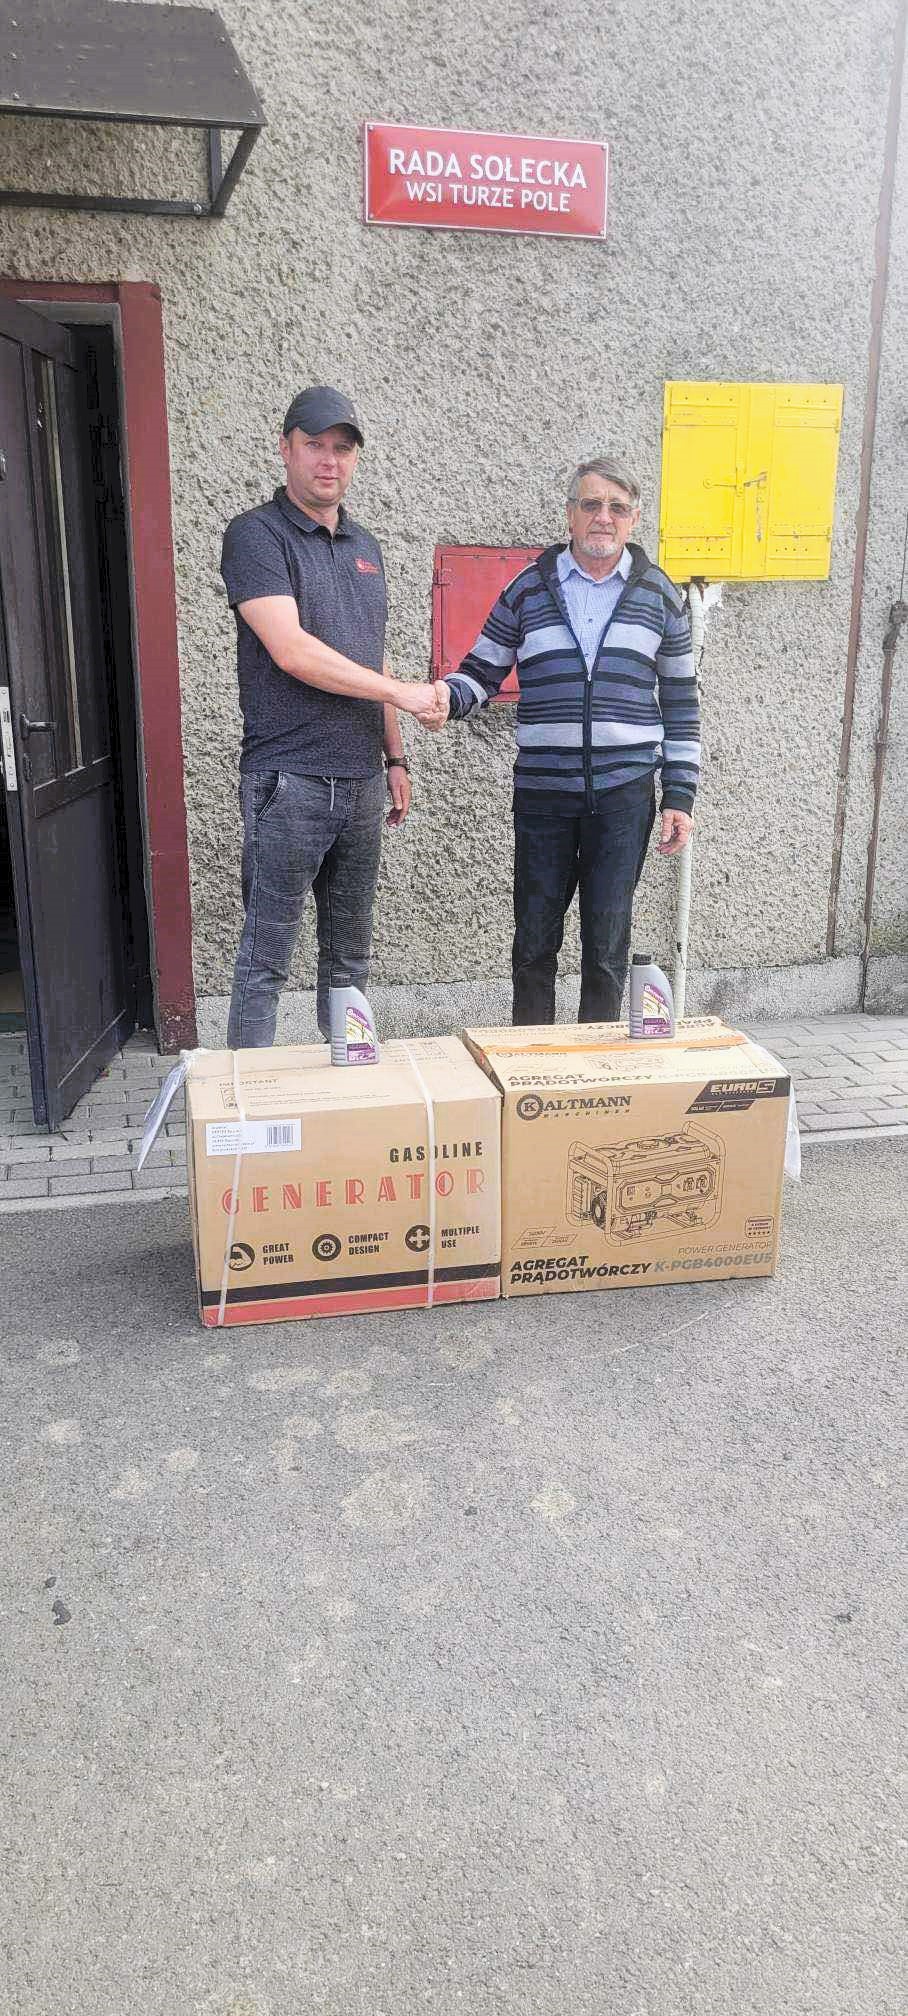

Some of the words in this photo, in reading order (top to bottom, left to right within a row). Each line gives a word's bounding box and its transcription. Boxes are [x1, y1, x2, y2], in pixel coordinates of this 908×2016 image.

[389, 149, 463, 178] RADA
[470, 154, 587, 189] SOŁECKA
[406, 181, 443, 203] WSI
[449, 184, 514, 208] TURZE
[521, 189, 571, 212] POLE
[710, 1082, 757, 1093] EURO
[222, 1168, 485, 1216] GENERATOR
[441, 1225, 480, 1237] MULTIPLE
[348, 1232, 389, 1244] COMPACT
[441, 1239, 457, 1249] USE
[262, 1242, 290, 1254] GREAT
[348, 1244, 380, 1256] DESIGN
[678, 1246, 713, 1255] POWER
[263, 1254, 294, 1265] POWER
[510, 1256, 589, 1272] AGREGAT
[510, 1262, 652, 1285] PRĄDOTWÓRCZY
